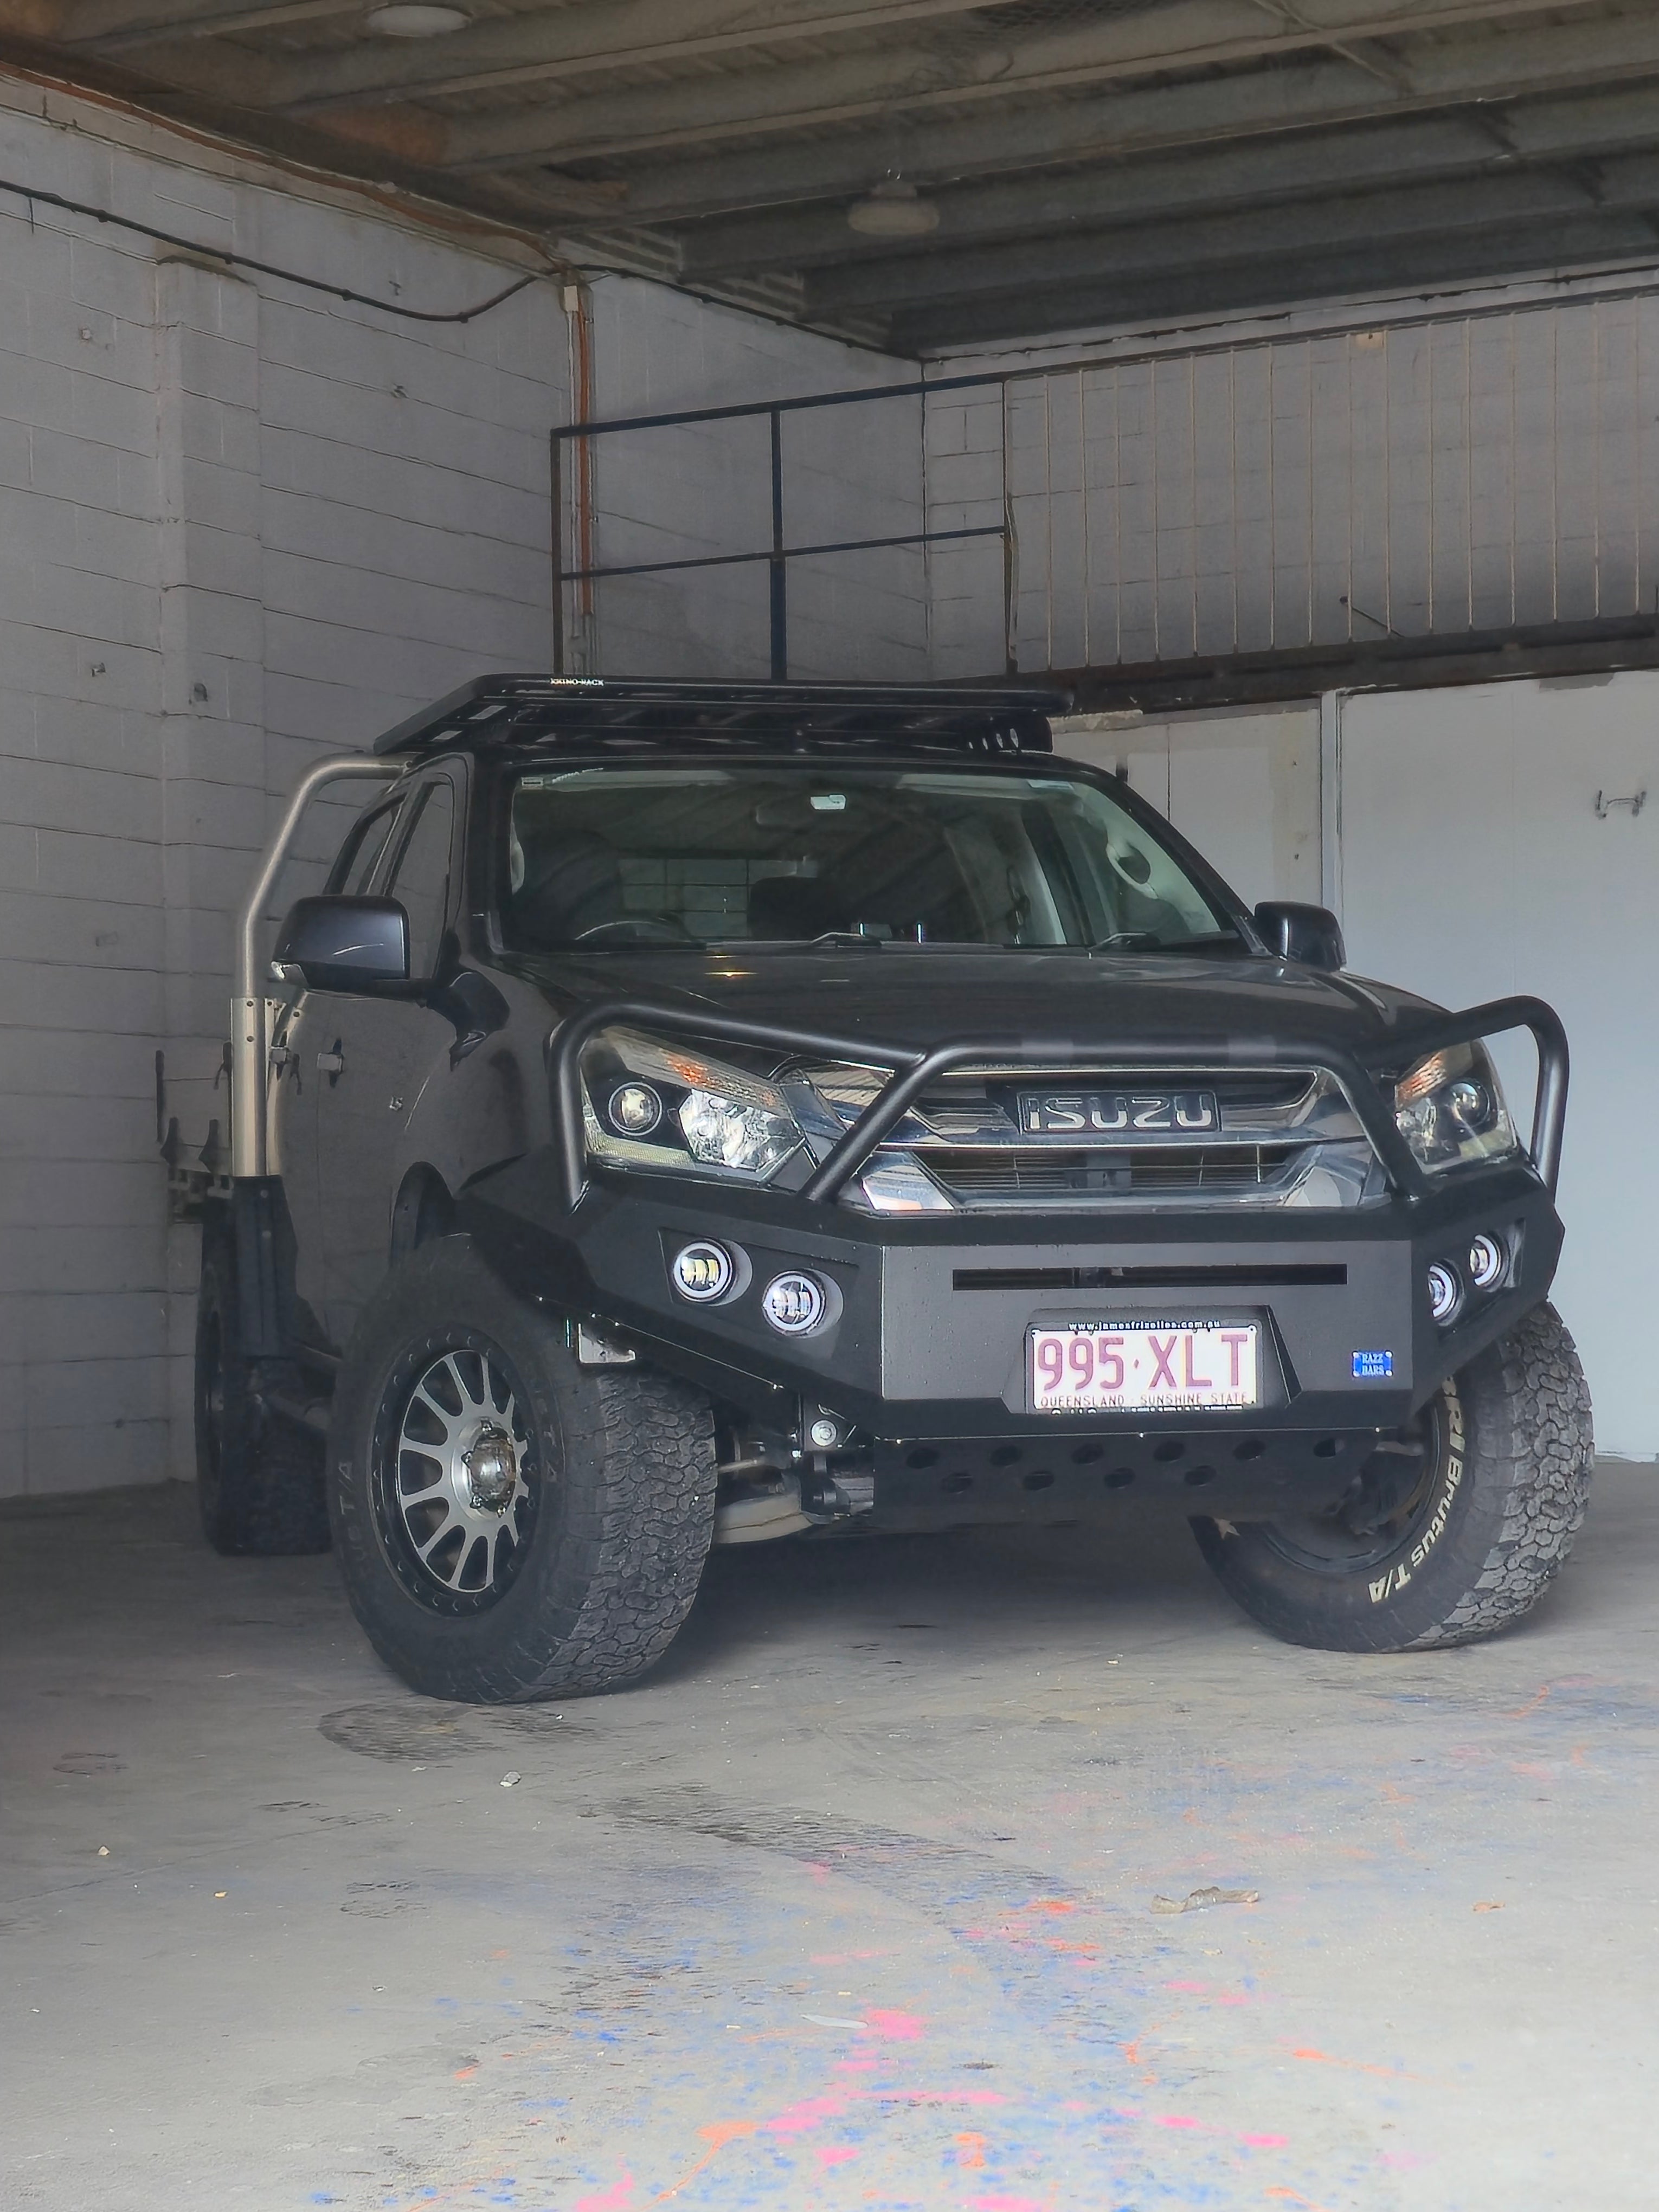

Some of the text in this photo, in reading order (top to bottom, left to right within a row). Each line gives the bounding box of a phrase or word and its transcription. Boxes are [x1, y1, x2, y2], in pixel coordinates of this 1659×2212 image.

[550, 678, 604, 686] RHINO-RACK
[1027, 1096, 1212, 1129] ISUZU
[1040, 1392, 1248, 1407] QUEENSLAND SUNSHINE STATE
[1411, 1454, 1463, 1567] Brutus
[1368, 1564, 1411, 1603] T/A
